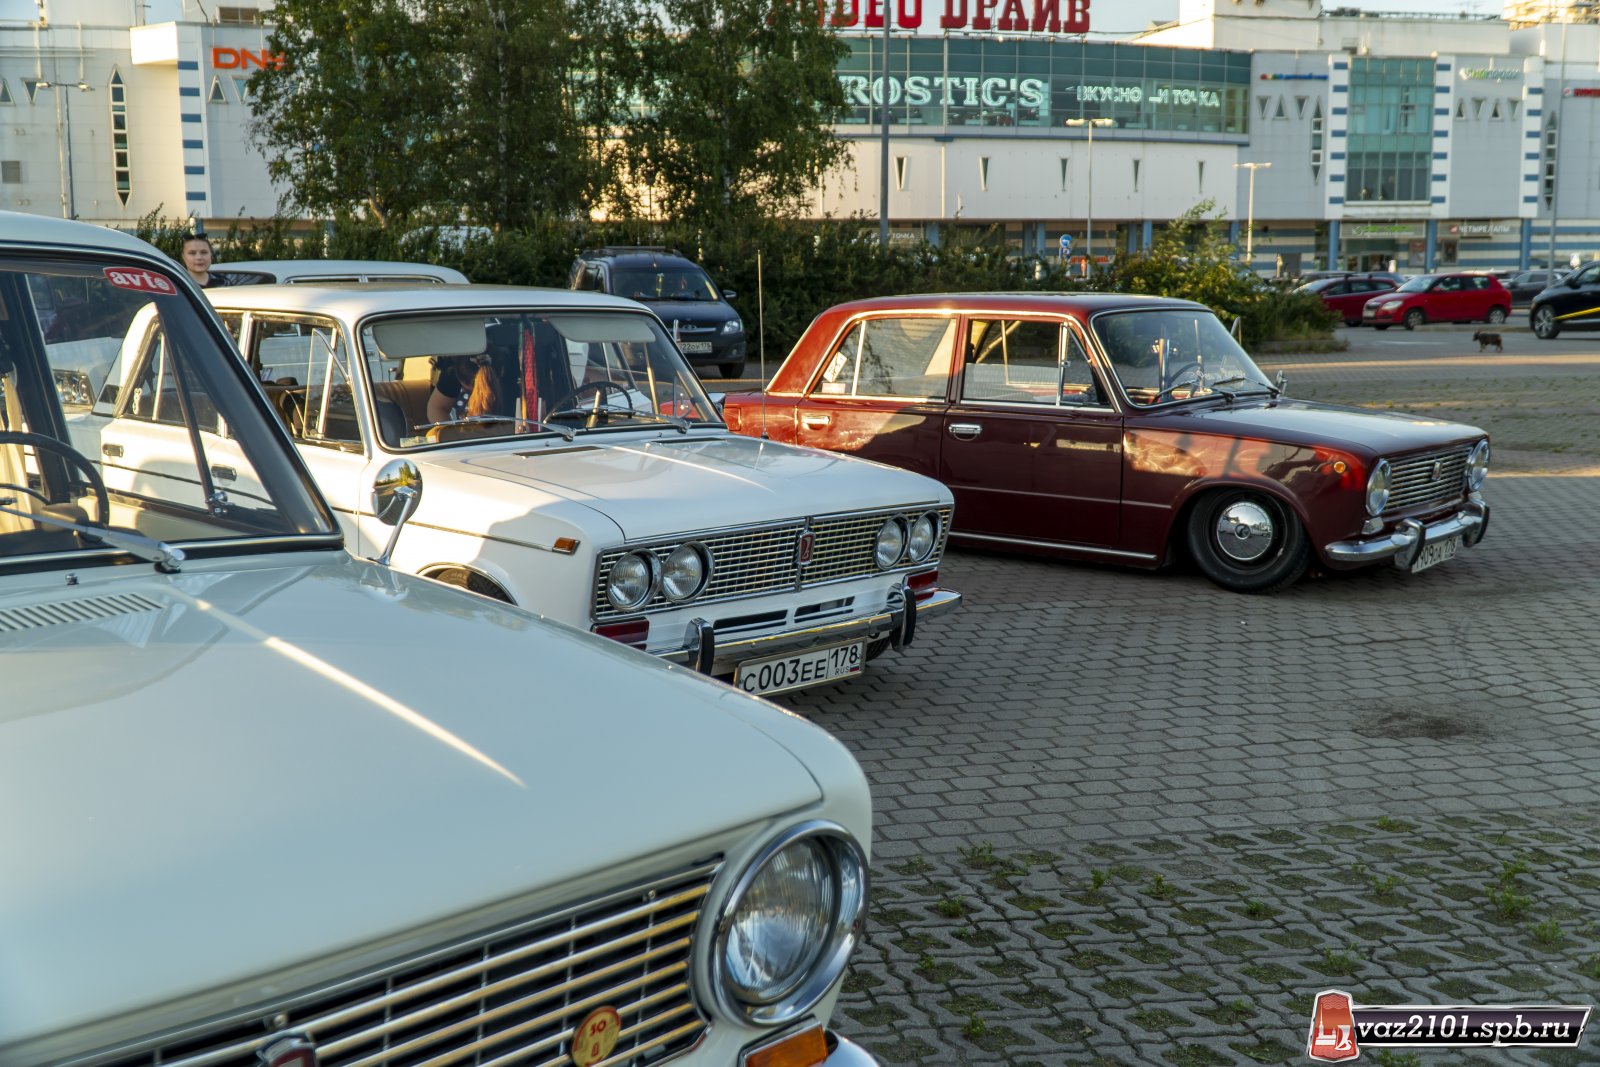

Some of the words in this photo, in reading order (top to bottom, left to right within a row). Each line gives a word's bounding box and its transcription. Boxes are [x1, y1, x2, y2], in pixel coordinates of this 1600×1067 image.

[839, 75, 1045, 107] ROSTIC'S
[831, 645, 859, 668] 178
[834, 665, 850, 676] RUS
